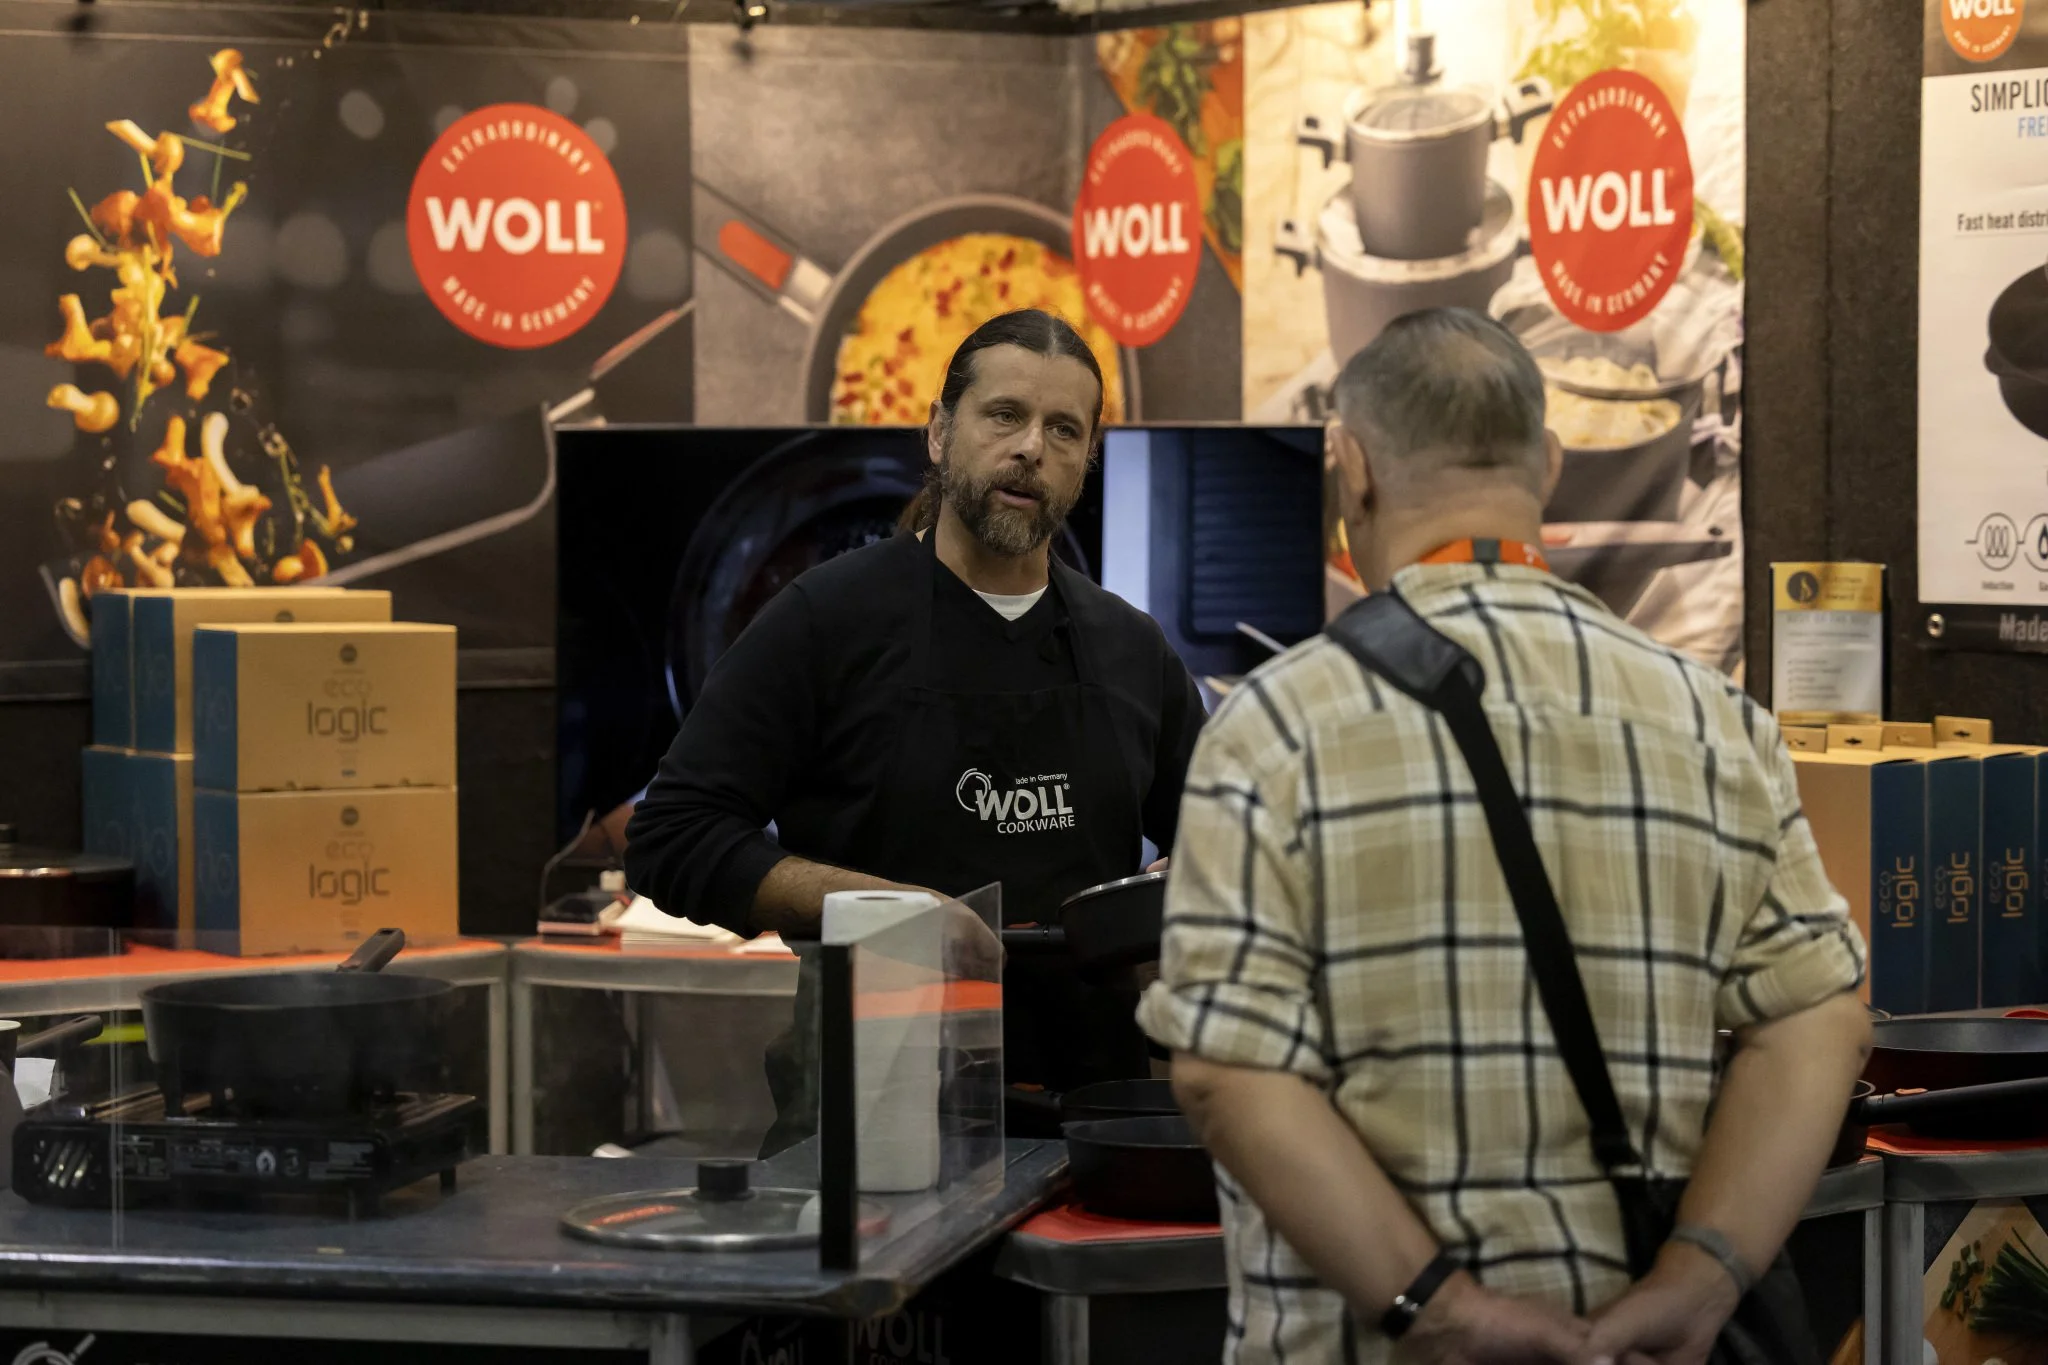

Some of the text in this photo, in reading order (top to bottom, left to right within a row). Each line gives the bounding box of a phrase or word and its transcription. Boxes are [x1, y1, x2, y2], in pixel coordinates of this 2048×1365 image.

[2018, 115, 2048, 138] FRE
[425, 197, 605, 255] WOLL
[1540, 168, 1676, 234] WOLL
[1958, 212, 1983, 232] Fast
[1987, 211, 2014, 230] heat
[1084, 202, 1190, 259] WOLL
[307, 698, 389, 744] logic
[1037, 772, 1068, 782] Germany
[997, 814, 1076, 834] COOKWARE
[308, 860, 391, 906] logic
[1891, 855, 1919, 928] logic
[1946, 851, 1974, 924] logic
[2000, 847, 2029, 918] logic
